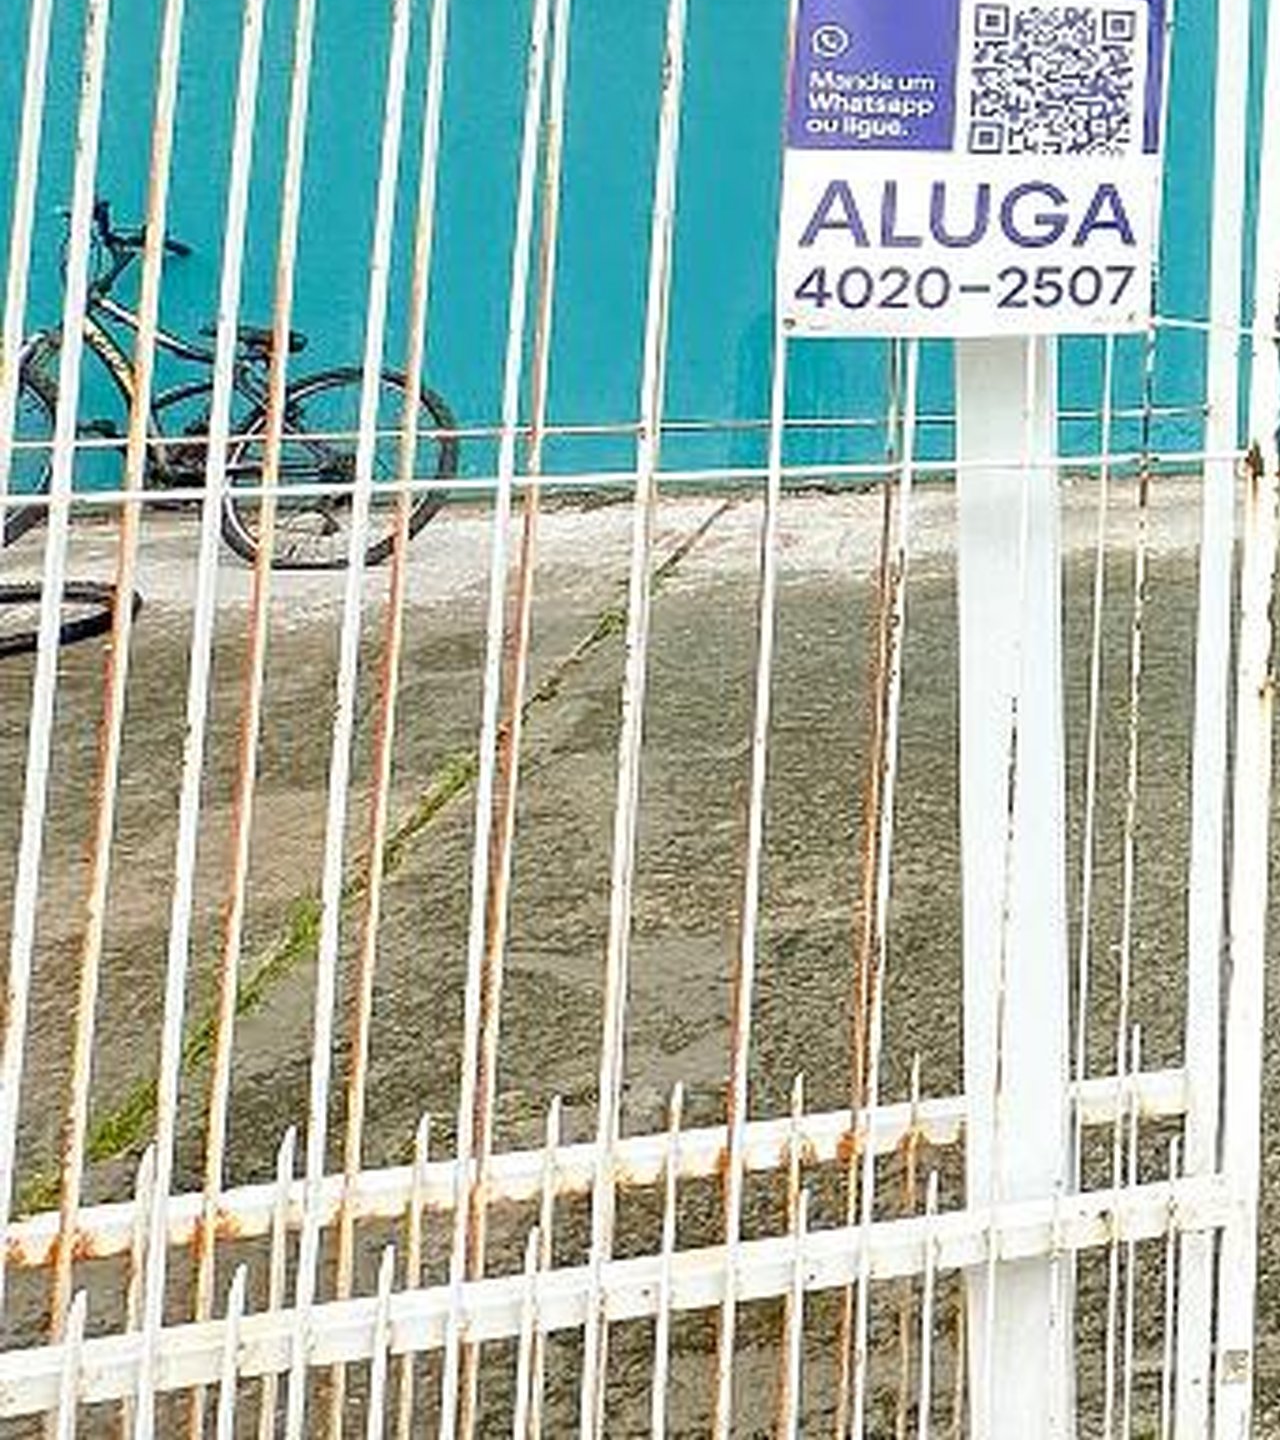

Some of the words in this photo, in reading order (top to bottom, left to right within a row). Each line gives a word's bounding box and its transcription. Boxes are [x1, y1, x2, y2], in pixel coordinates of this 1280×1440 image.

[898, 76, 936, 92] um
[808, 92, 936, 118] Whatsapp
[805, 118, 839, 134] ou
[843, 116, 909, 139] ligue.
[797, 179, 1137, 249] ALUGA
[793, 264, 1138, 310] 4020-2507
